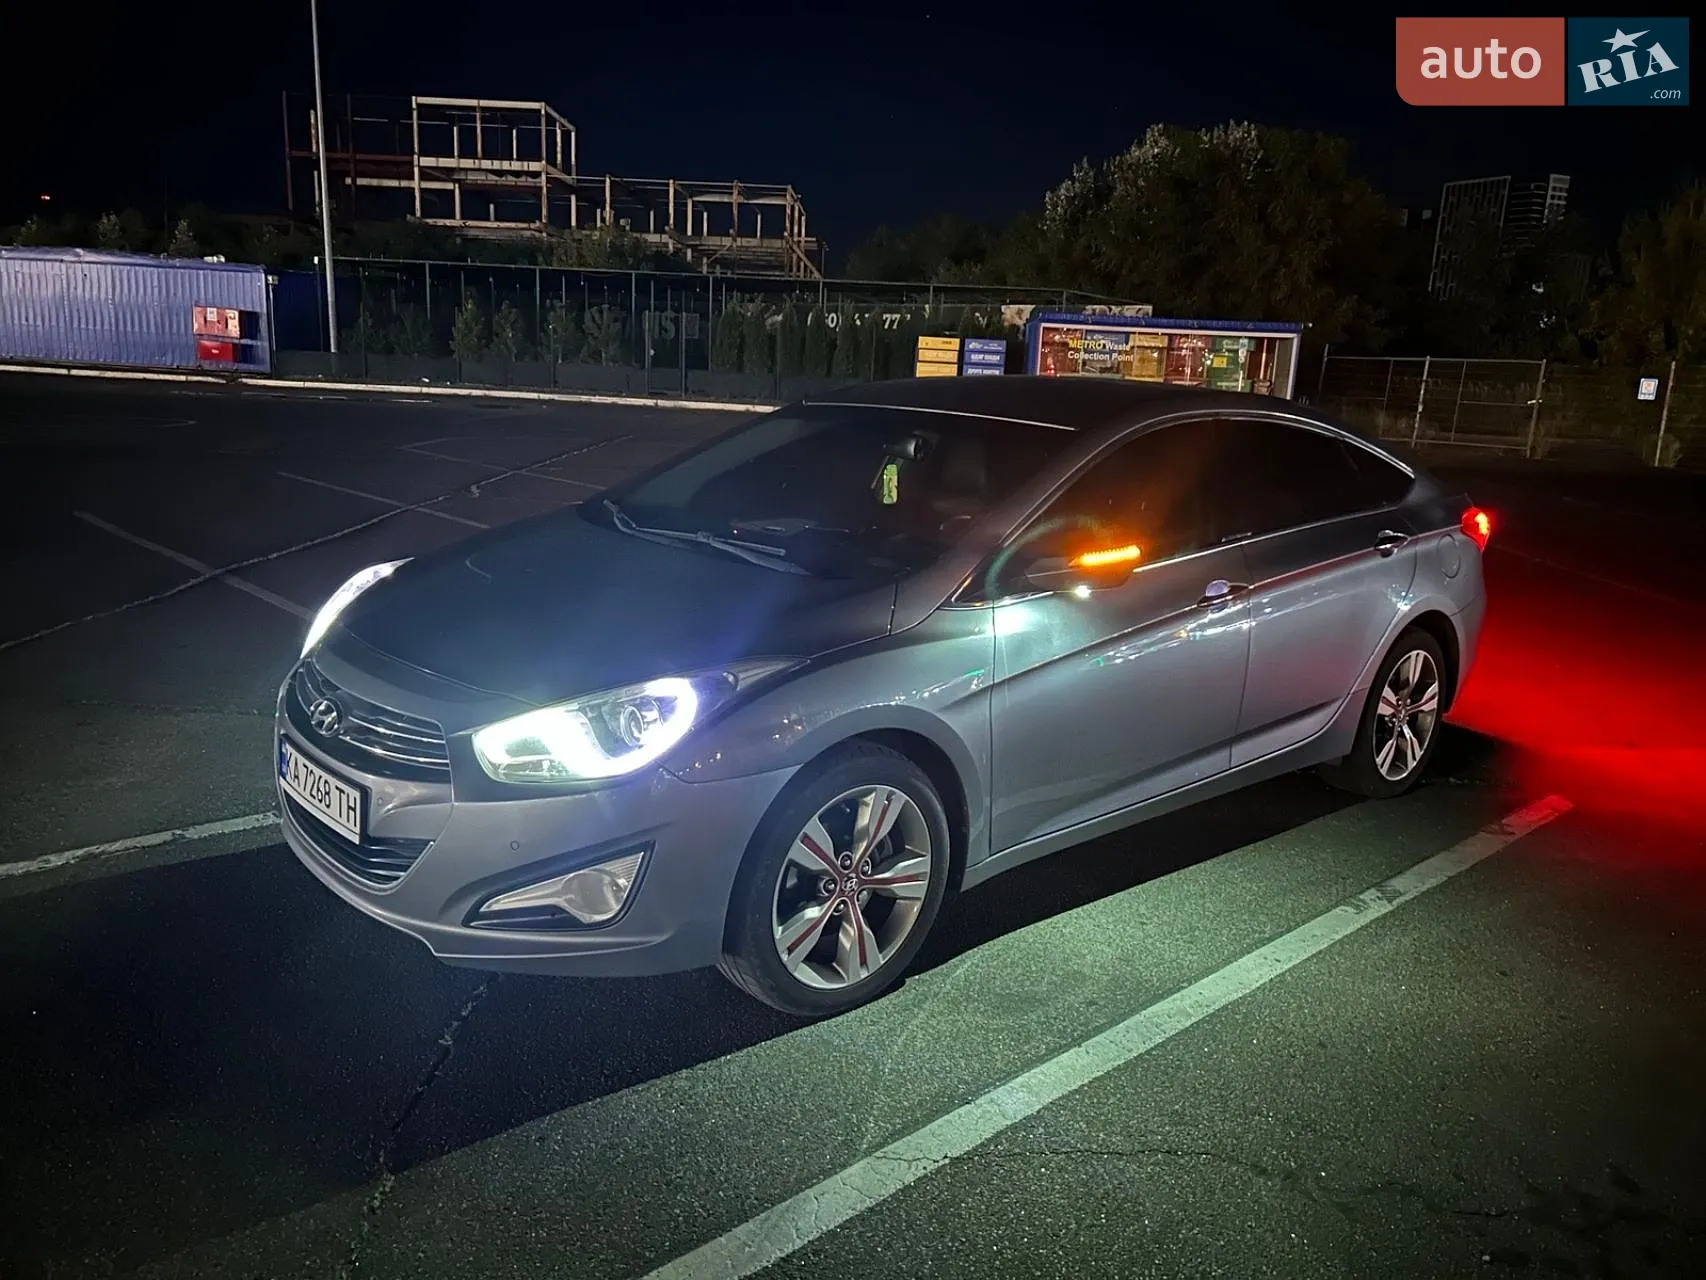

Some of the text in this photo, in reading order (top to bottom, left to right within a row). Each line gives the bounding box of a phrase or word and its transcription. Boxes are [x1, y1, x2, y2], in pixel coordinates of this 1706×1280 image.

[1068, 338, 1131, 351] METRO Waste
[1068, 351, 1134, 362] Collection Point
[303, 764, 331, 809] 7268
[335, 785, 357, 827] TH
